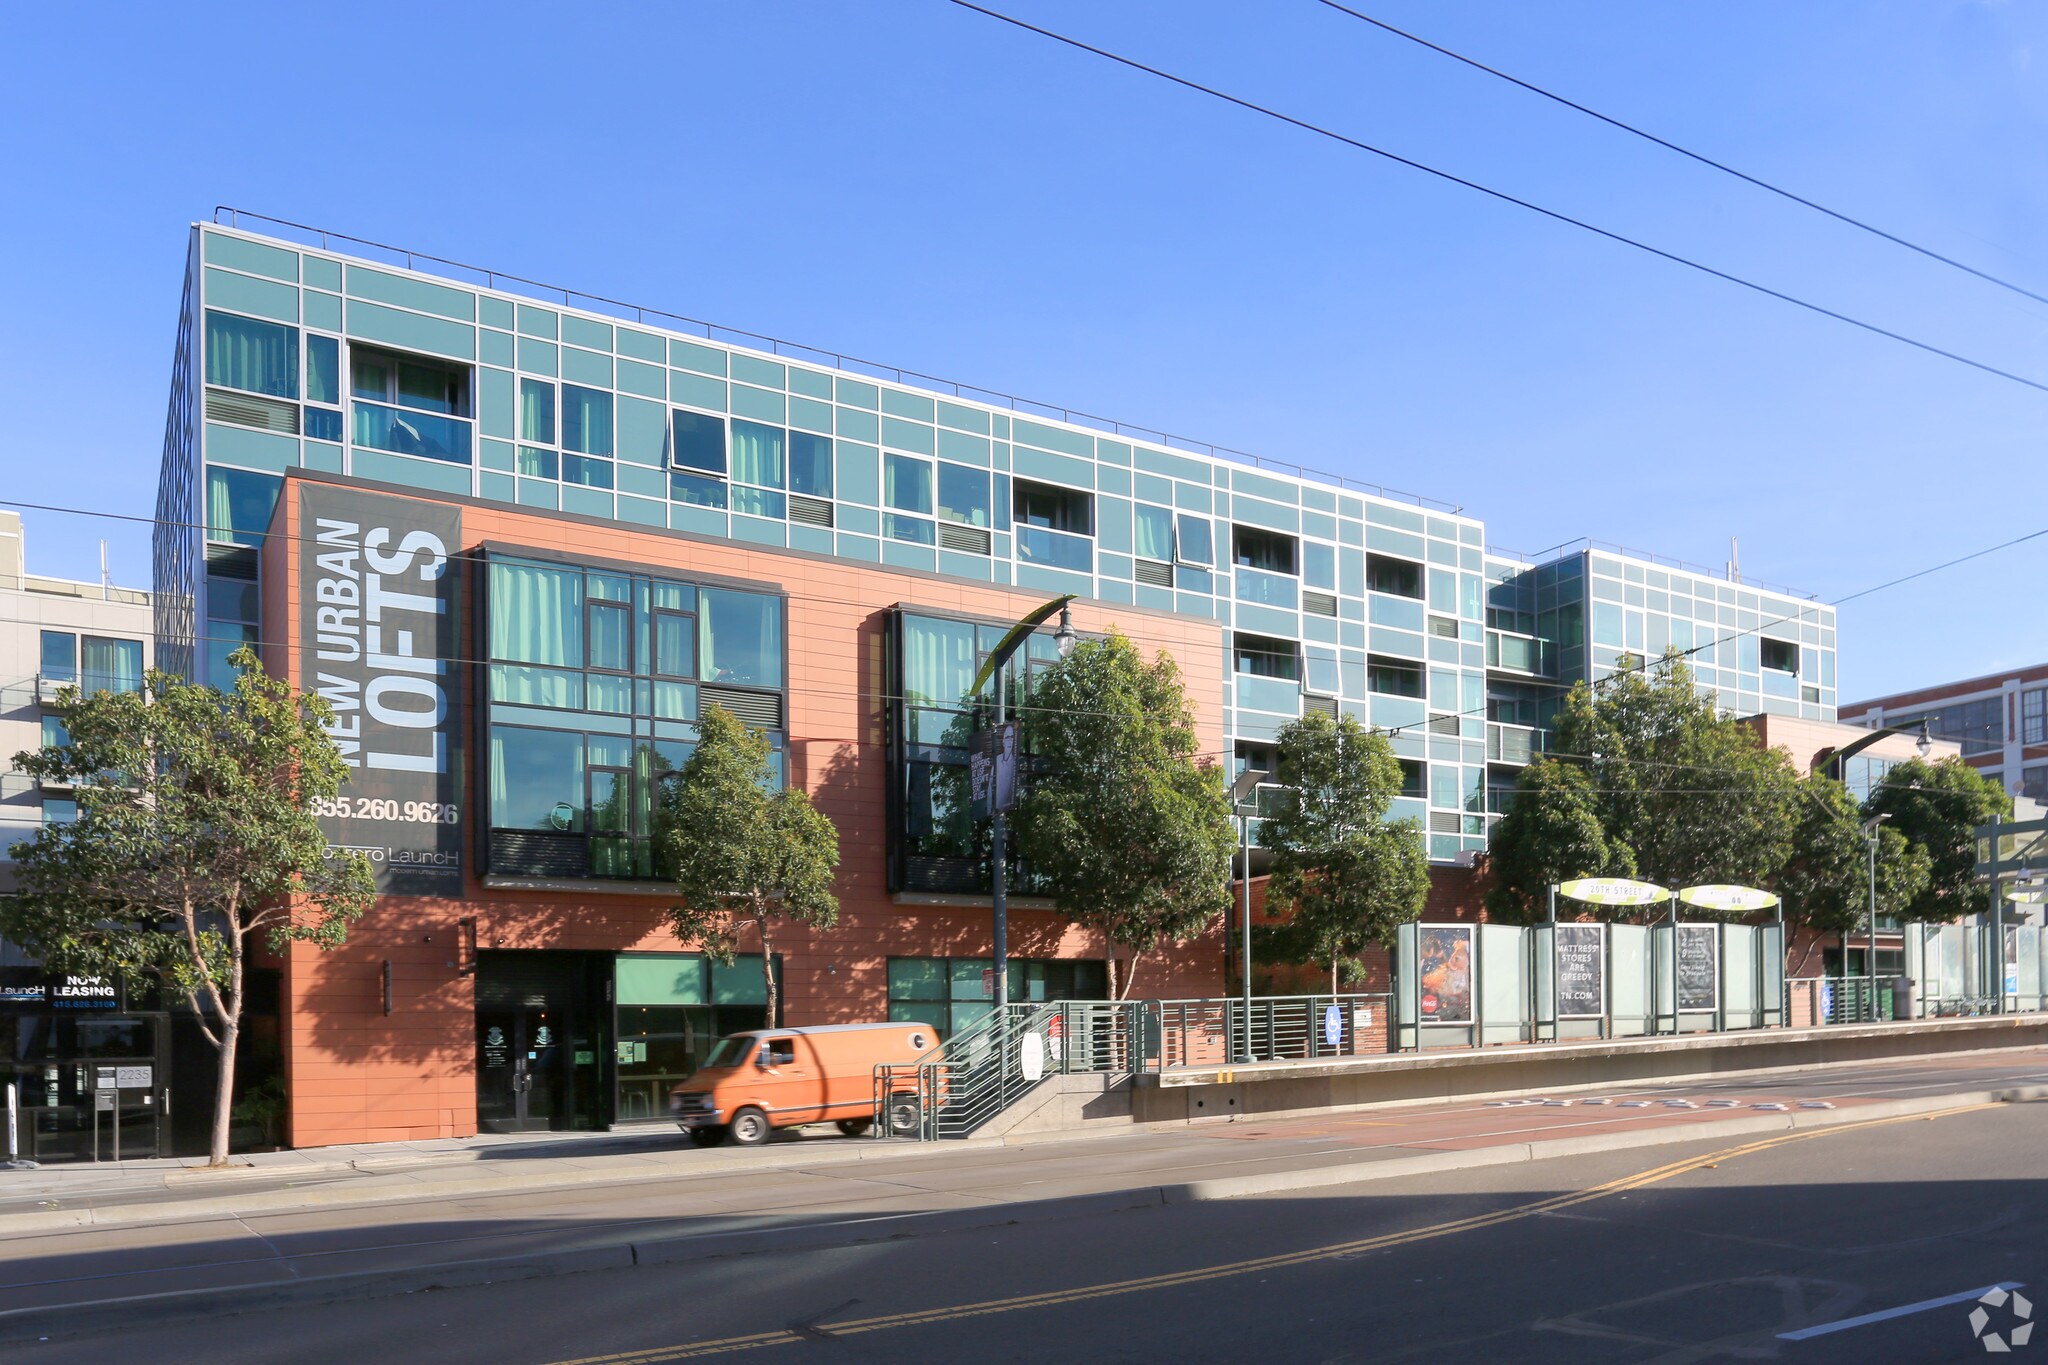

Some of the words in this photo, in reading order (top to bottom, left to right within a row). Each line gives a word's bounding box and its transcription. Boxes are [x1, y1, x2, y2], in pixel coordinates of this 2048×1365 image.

[316, 518, 361, 662] URBAN
[364, 527, 448, 774] LOFTS
[310, 795, 458, 824] 855.260.9626
[1614, 886, 1642, 896] STREET
[1557, 944, 1597, 953] MATTRESS
[1561, 954, 1592, 962] STORES
[1569, 963, 1585, 972] ARE
[1561, 973, 1593, 981] GREEDY
[53, 986, 115, 996] LEASING
[1561, 992, 1593, 1000] TN.COM
[119, 1069, 150, 1080] 2235
